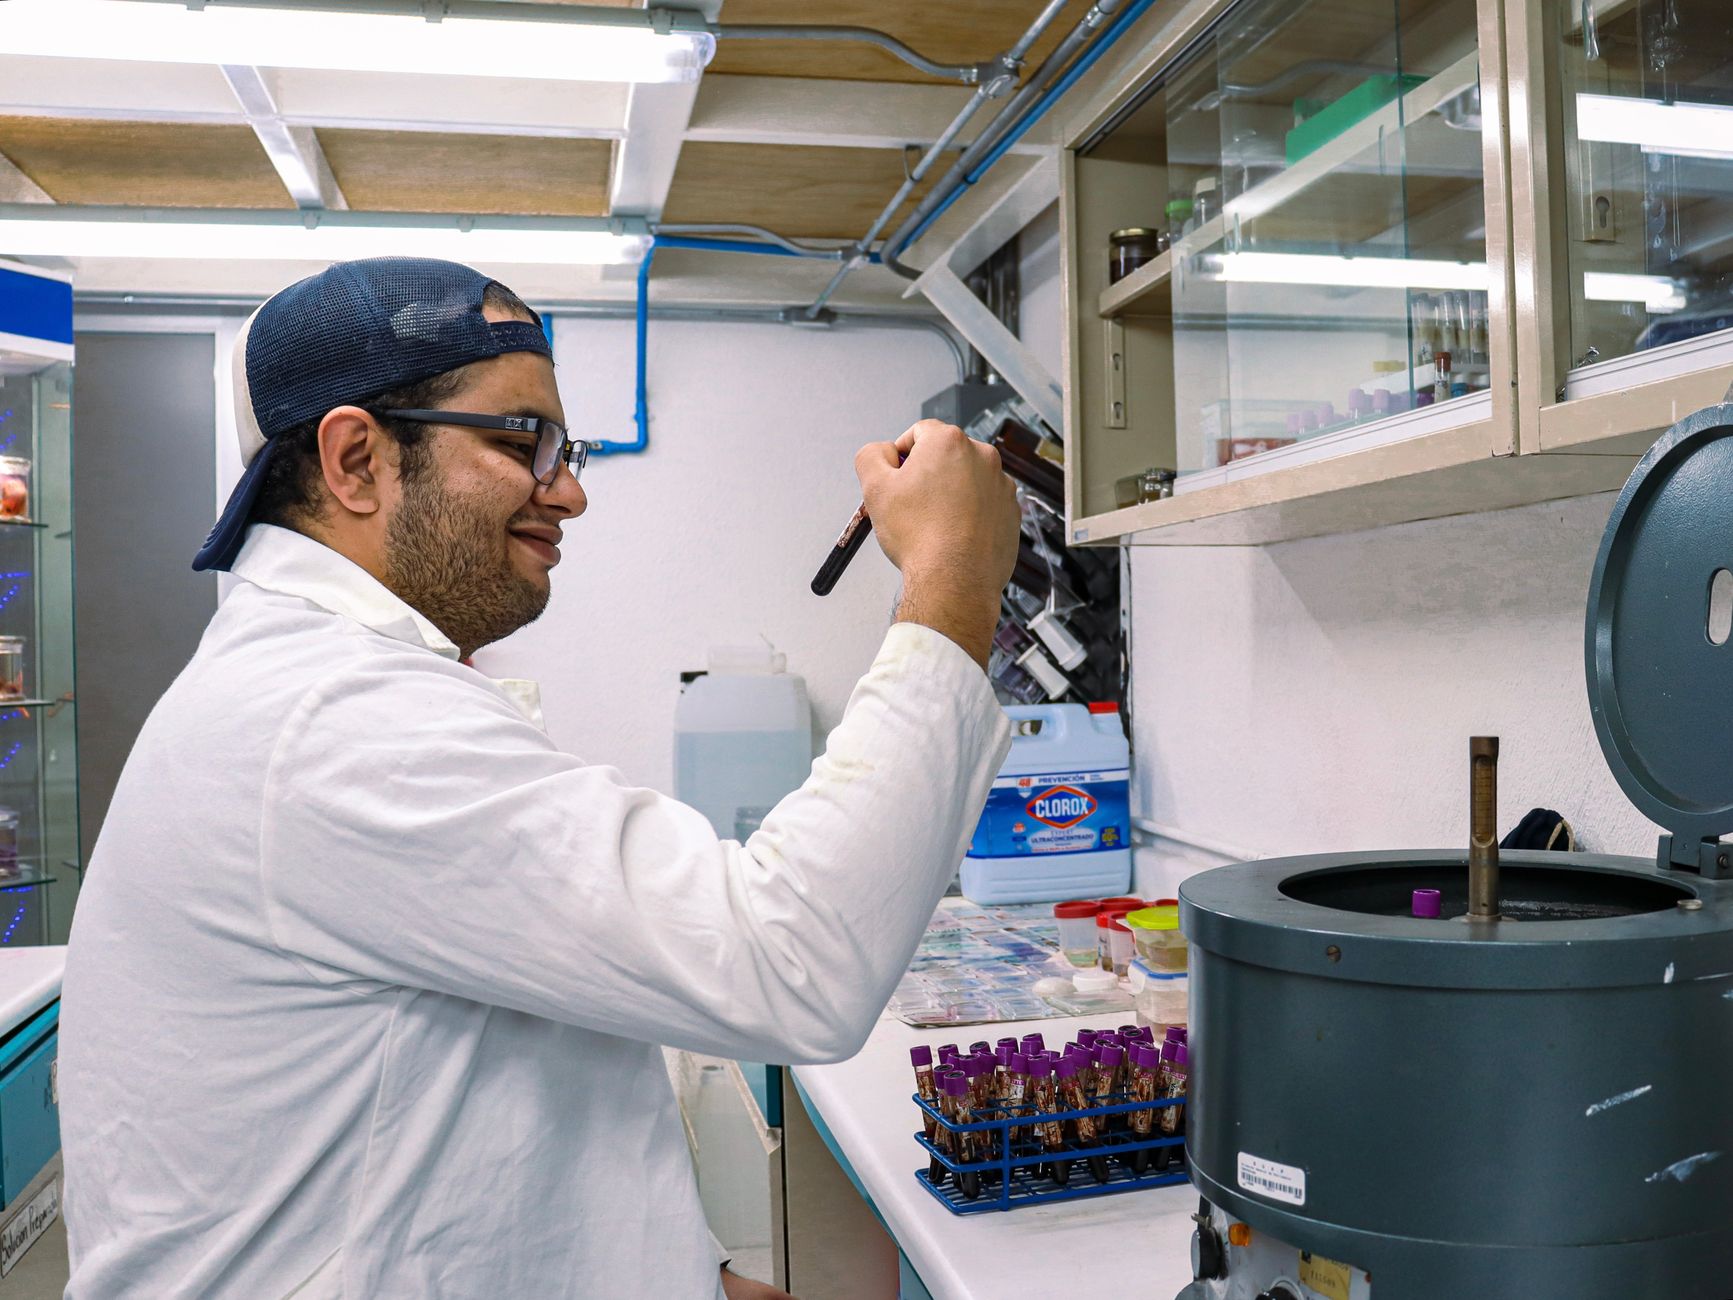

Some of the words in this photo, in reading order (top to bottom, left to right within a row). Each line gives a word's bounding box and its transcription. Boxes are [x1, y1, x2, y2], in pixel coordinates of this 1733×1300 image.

[1039, 774, 1085, 783] PREVENCIÓN
[1035, 797, 1088, 817] CLOROX
[1031, 834, 1094, 843] ULTRACONCENTRADO
